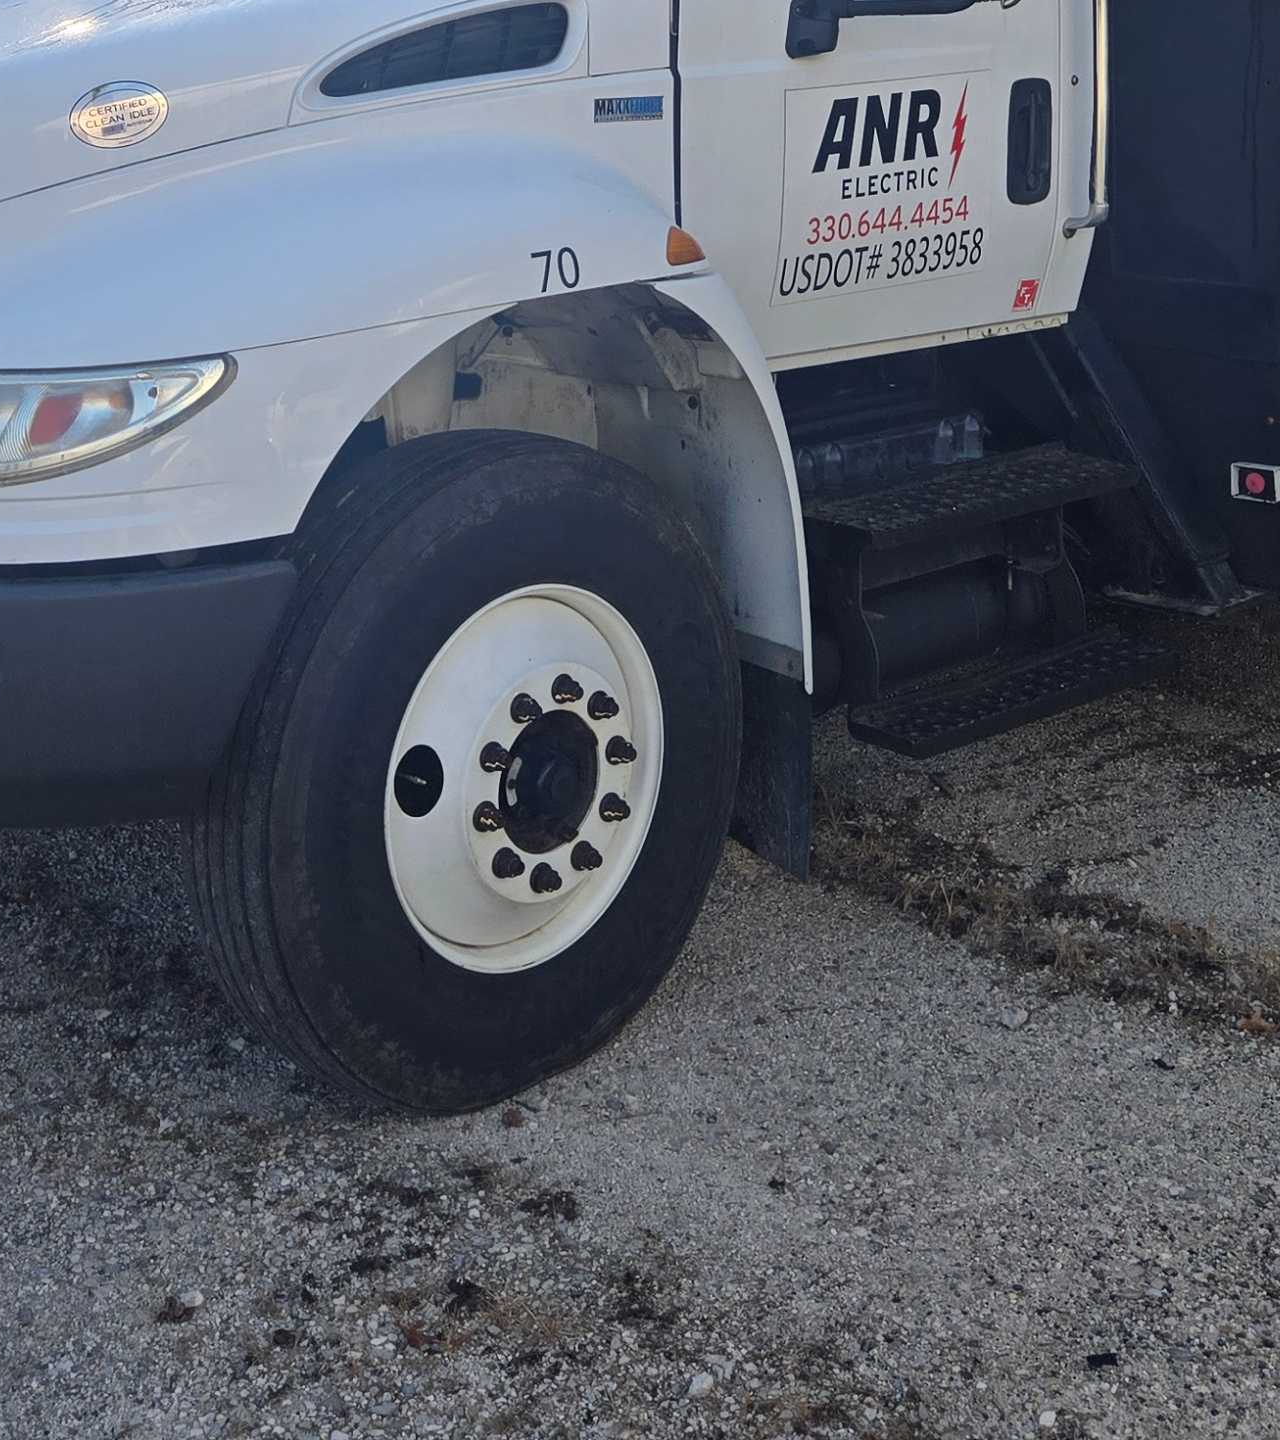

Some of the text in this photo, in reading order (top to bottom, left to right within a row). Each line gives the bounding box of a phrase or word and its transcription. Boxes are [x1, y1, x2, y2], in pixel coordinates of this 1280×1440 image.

[85, 113, 125, 129] CLEAN
[129, 107, 155, 120] IDLE
[88, 98, 148, 117] CERTIFIED
[812, 89, 942, 174] ANR
[841, 167, 939, 200] ELECTRIC
[806, 195, 969, 245] 330.644.4454
[530, 247, 580, 293] 70
[779, 227, 984, 297] USDOT# 3833958
